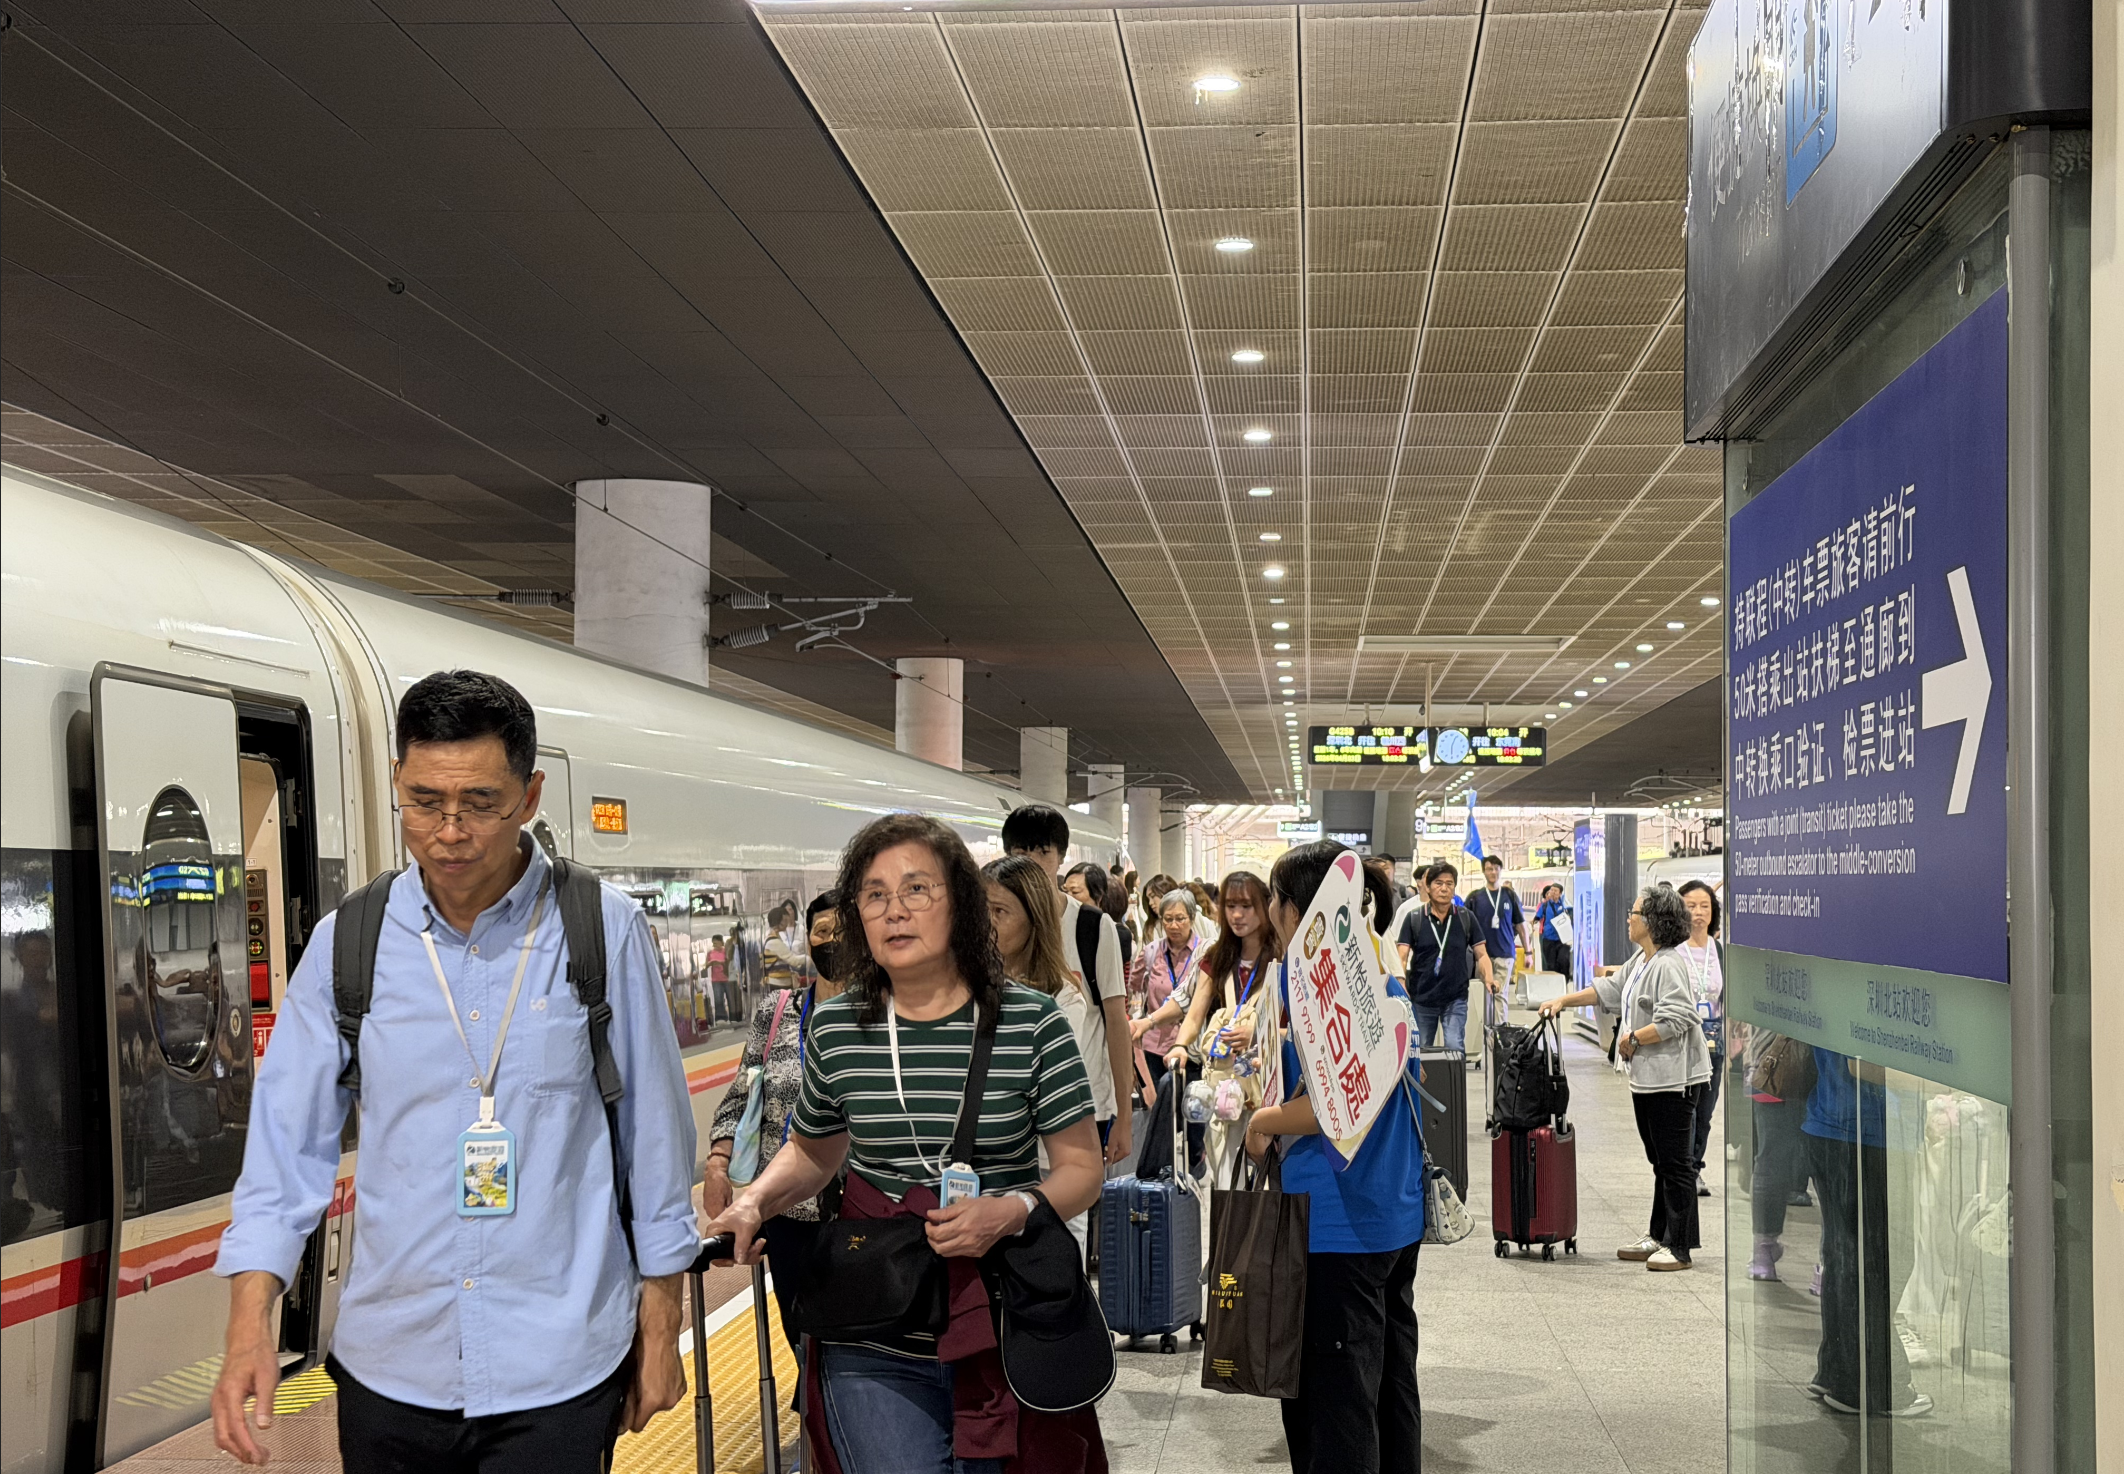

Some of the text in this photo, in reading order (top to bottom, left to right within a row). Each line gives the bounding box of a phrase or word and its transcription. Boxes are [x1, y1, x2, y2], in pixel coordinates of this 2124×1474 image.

[1734, 583, 1916, 722] 50米搭乘出站扶梯至通廊到
[1734, 814, 1766, 845] Passengers
[1767, 809, 1779, 837] with
[1784, 807, 1799, 842] joint
[1800, 802, 1826, 842] (transit)
[1827, 800, 1848, 832] ticket
[1849, 797, 1877, 837] please
[1878, 793, 1897, 826] take
[1899, 790, 1914, 824] the
[1760, 848, 1787, 876] outbound
[1787, 847, 1817, 876] escalator
[1818, 847, 1825, 876] to
[1826, 846, 1838, 876] the
[1839, 839, 1916, 875] middle-conversion
[1734, 887, 1820, 918] pass verification and check-in
[1290, 970, 1316, 1044] 2117 9799
[1340, 953, 1371, 1059] SKYWARDS TRAVEL
[1344, 933, 1385, 1051] 新怡旅遊
[1866, 979, 1931, 1028] 深圳北站欢迎您
[1310, 948, 1372, 1127] 集合處
[1910, 1034, 1931, 1064] Railway
[1932, 1040, 1954, 1065] Station
[1316, 1060, 1343, 1142] 6994 8005
